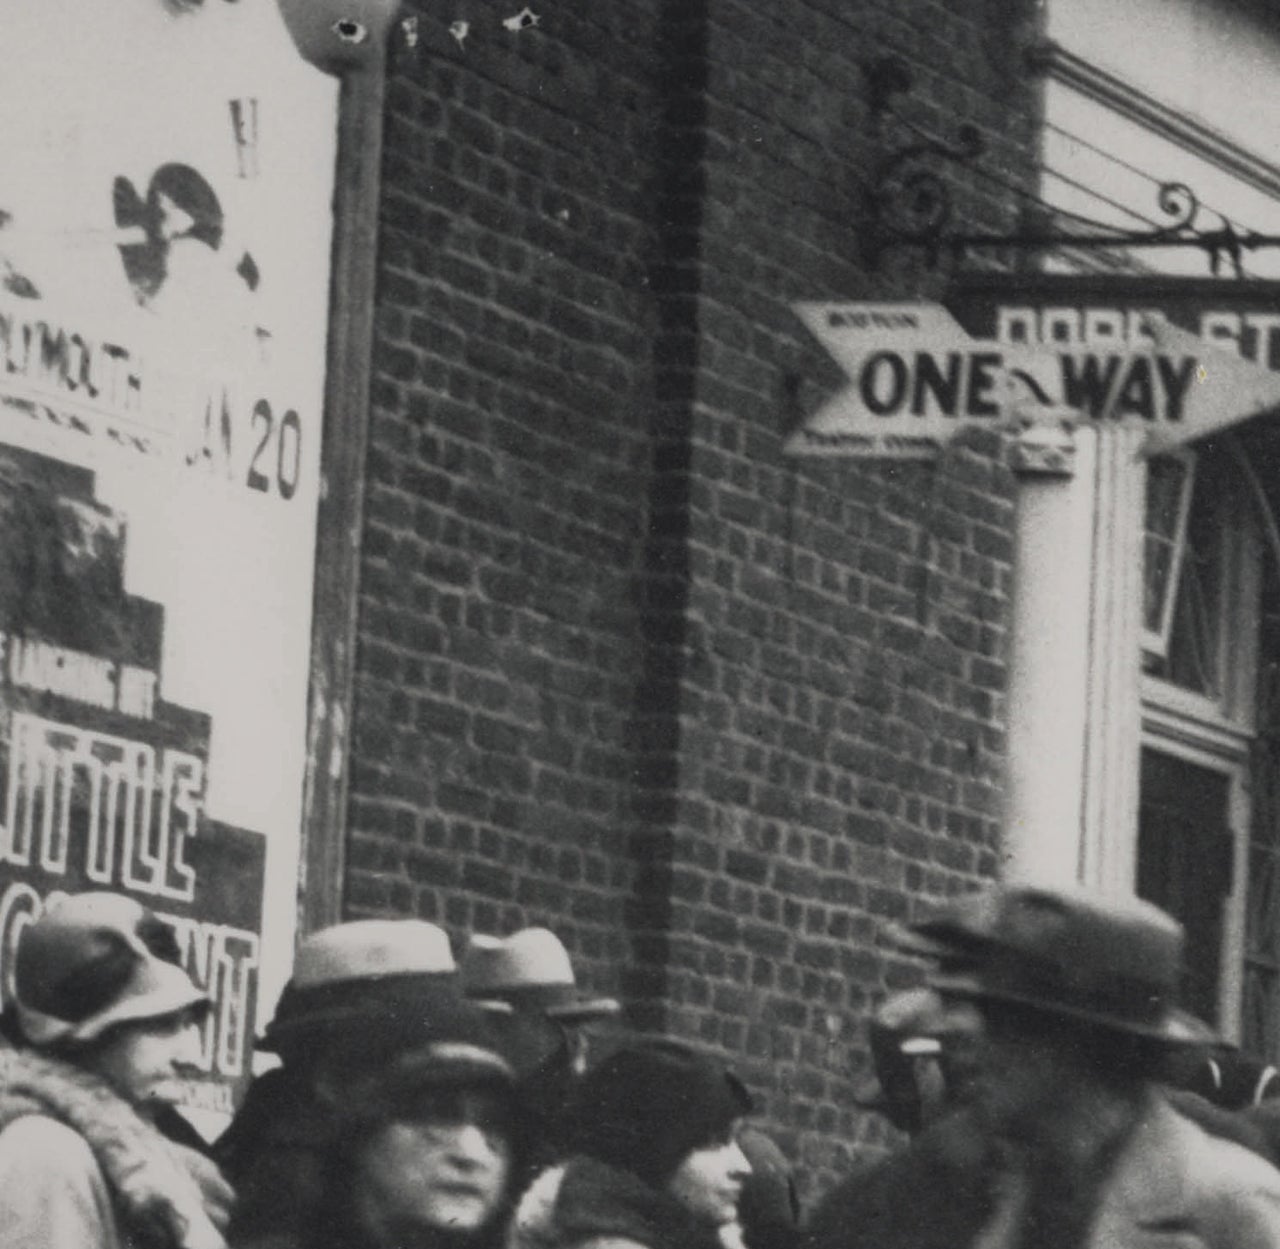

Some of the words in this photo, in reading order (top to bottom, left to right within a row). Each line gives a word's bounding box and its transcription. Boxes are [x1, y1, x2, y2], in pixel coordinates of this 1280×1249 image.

[859, 350, 1003, 418] ONE
[1060, 352, 1198, 421] WAY
[246, 398, 301, 501] 20
[0, 710, 203, 902] ITTLE
